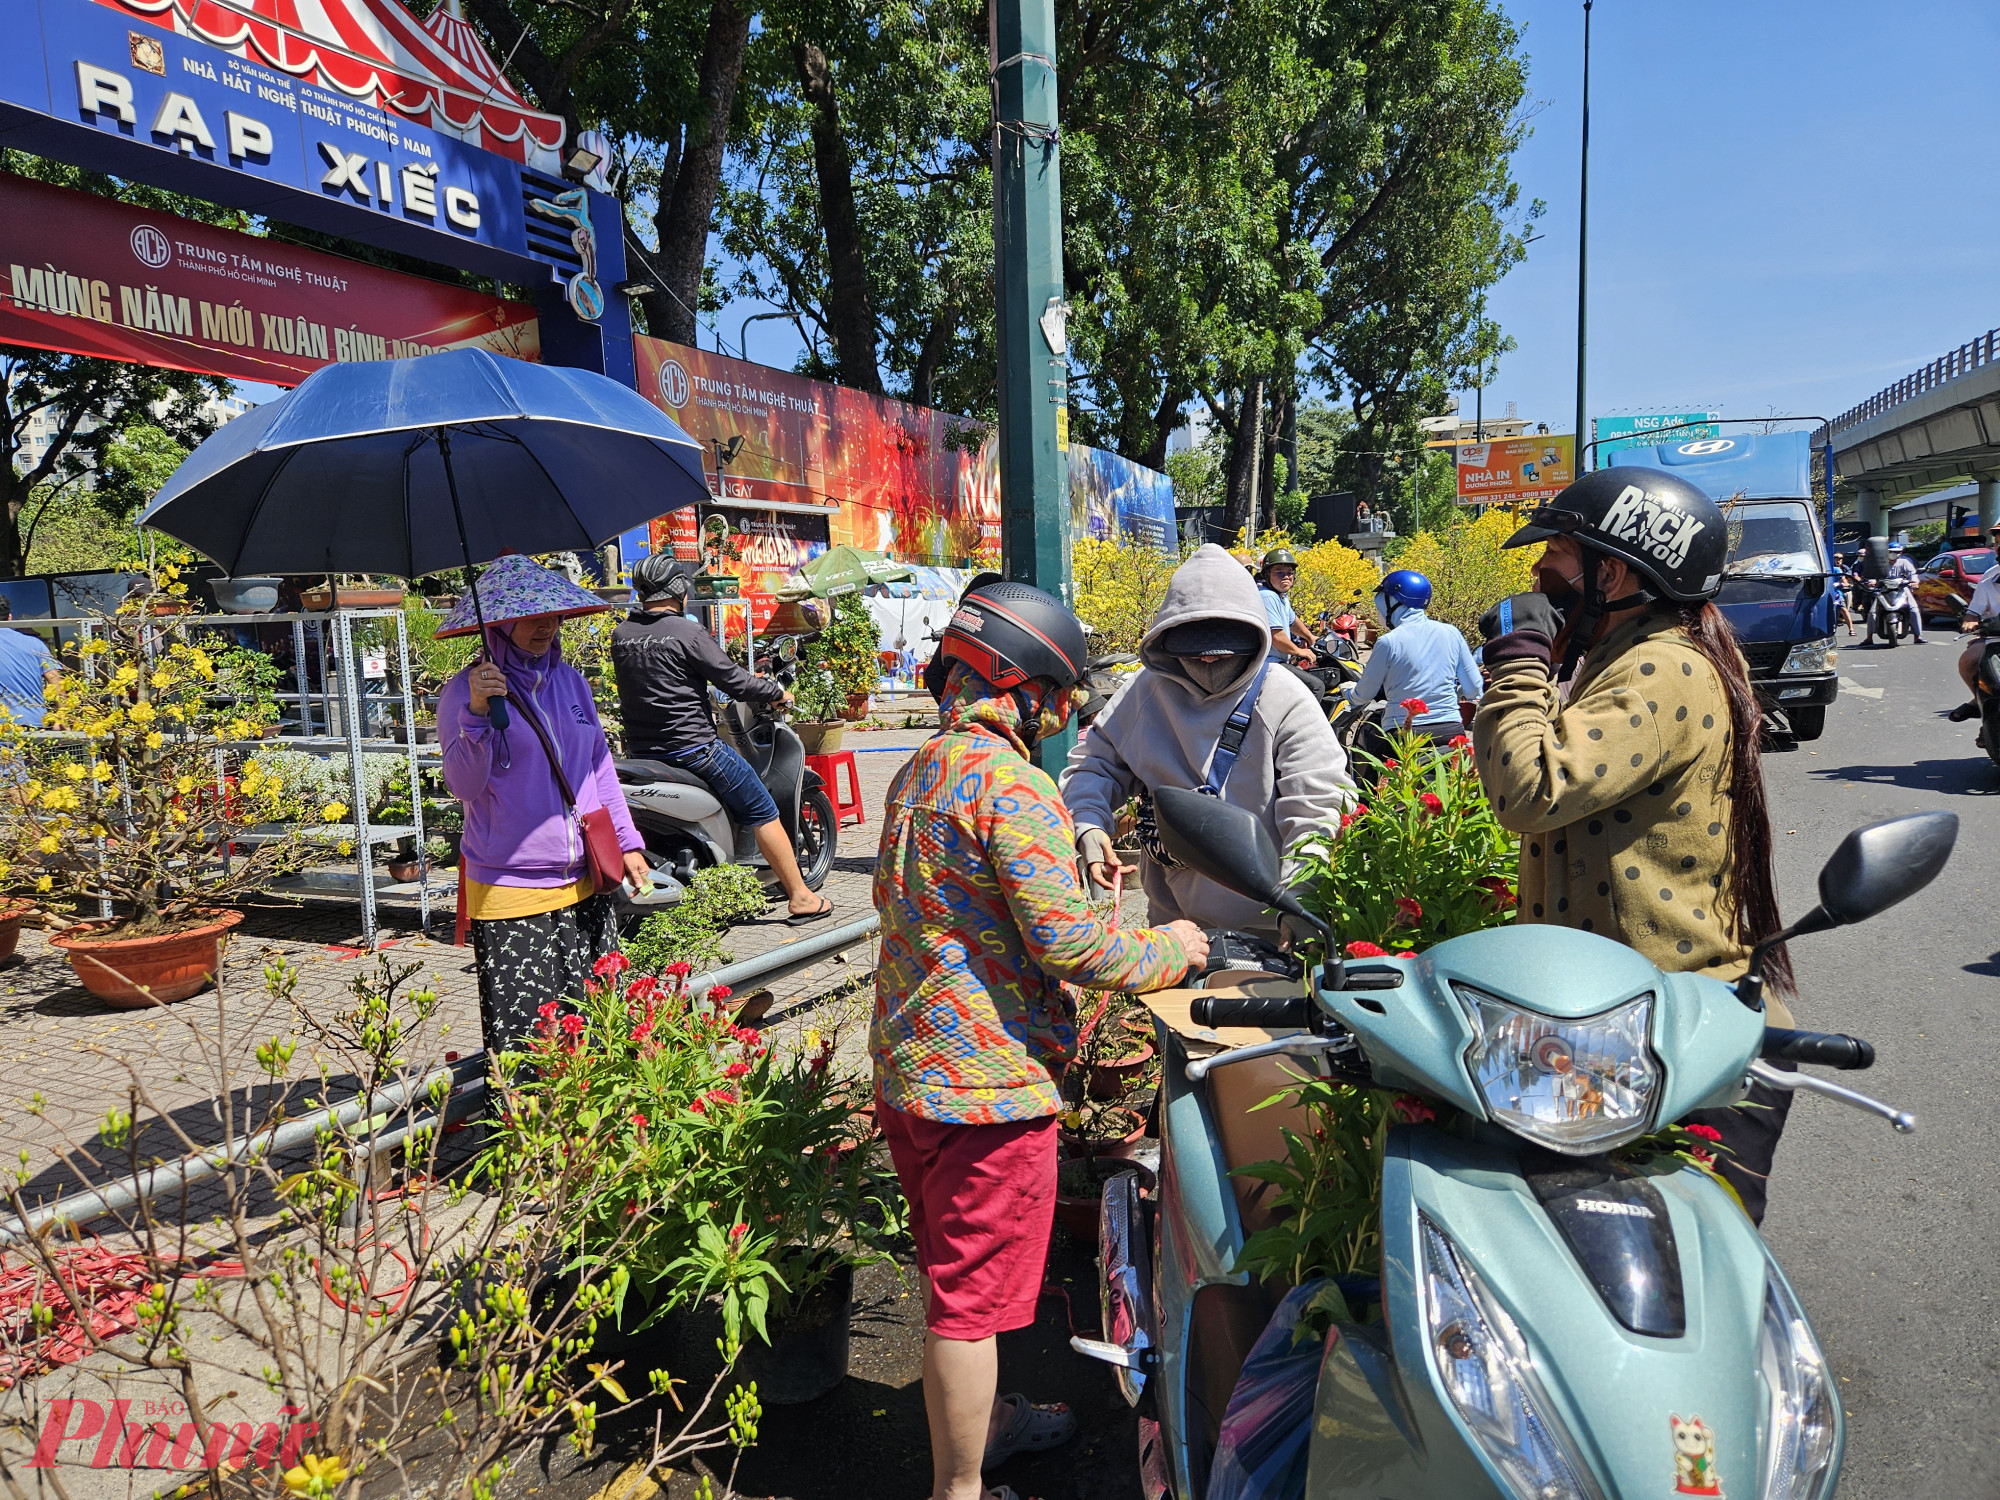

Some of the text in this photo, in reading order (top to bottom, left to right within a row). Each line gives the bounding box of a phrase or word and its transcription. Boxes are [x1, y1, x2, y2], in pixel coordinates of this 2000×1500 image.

[228, 60, 239, 70] SỞ
[242, 64, 257, 76] VĂN
[258, 70, 275, 84] HÓA
[313, 91, 339, 108] THÀNH
[339, 99, 354, 112] PHỐ
[367, 109, 380, 122] CHÍ
[183, 57, 431, 158] NHÀ HÁT NGHỆ THUẬT PHƯƠNG NAM
[74, 60, 480, 228] RẠP XIẾC
[175, 241, 227, 264] TRUNG
[231, 254, 262, 273] TÂM
[265, 263, 303, 284] NGHỆ
[305, 272, 348, 293] THUẬT
[177, 258, 207, 273] THÀNH
[209, 265, 227, 277] PHỐ
[241, 273, 256, 283] CHÍ
[256, 277, 277, 288] MINH
[10, 262, 113, 324] MỪNG
[120, 284, 193, 337] NĂM
[200, 300, 255, 348] MỚI
[260, 312, 330, 361] XUÂN
[334, 324, 388, 362] BÍNH
[693, 375, 732, 396] TRUNG
[734, 384, 757, 402] TÂM
[759, 390, 787, 411] NGHỆ
[788, 397, 820, 417] THUẬT
[694, 396, 717, 408] THÀNH
[753, 408, 768, 418] MINH
[1634, 417, 1659, 429] NSG
[1465, 470, 1510, 483] NHÀ IN
[1644, 492, 1686, 520] WE WILL
[669, 528, 696, 538] HOTLINE
[1598, 485, 1706, 559] ROCK
[1641, 535, 1684, 570] YOU
[825, 569, 854, 581] VETC
[630, 788, 660, 797] SH
[1576, 1199, 1656, 1219] HONDA
